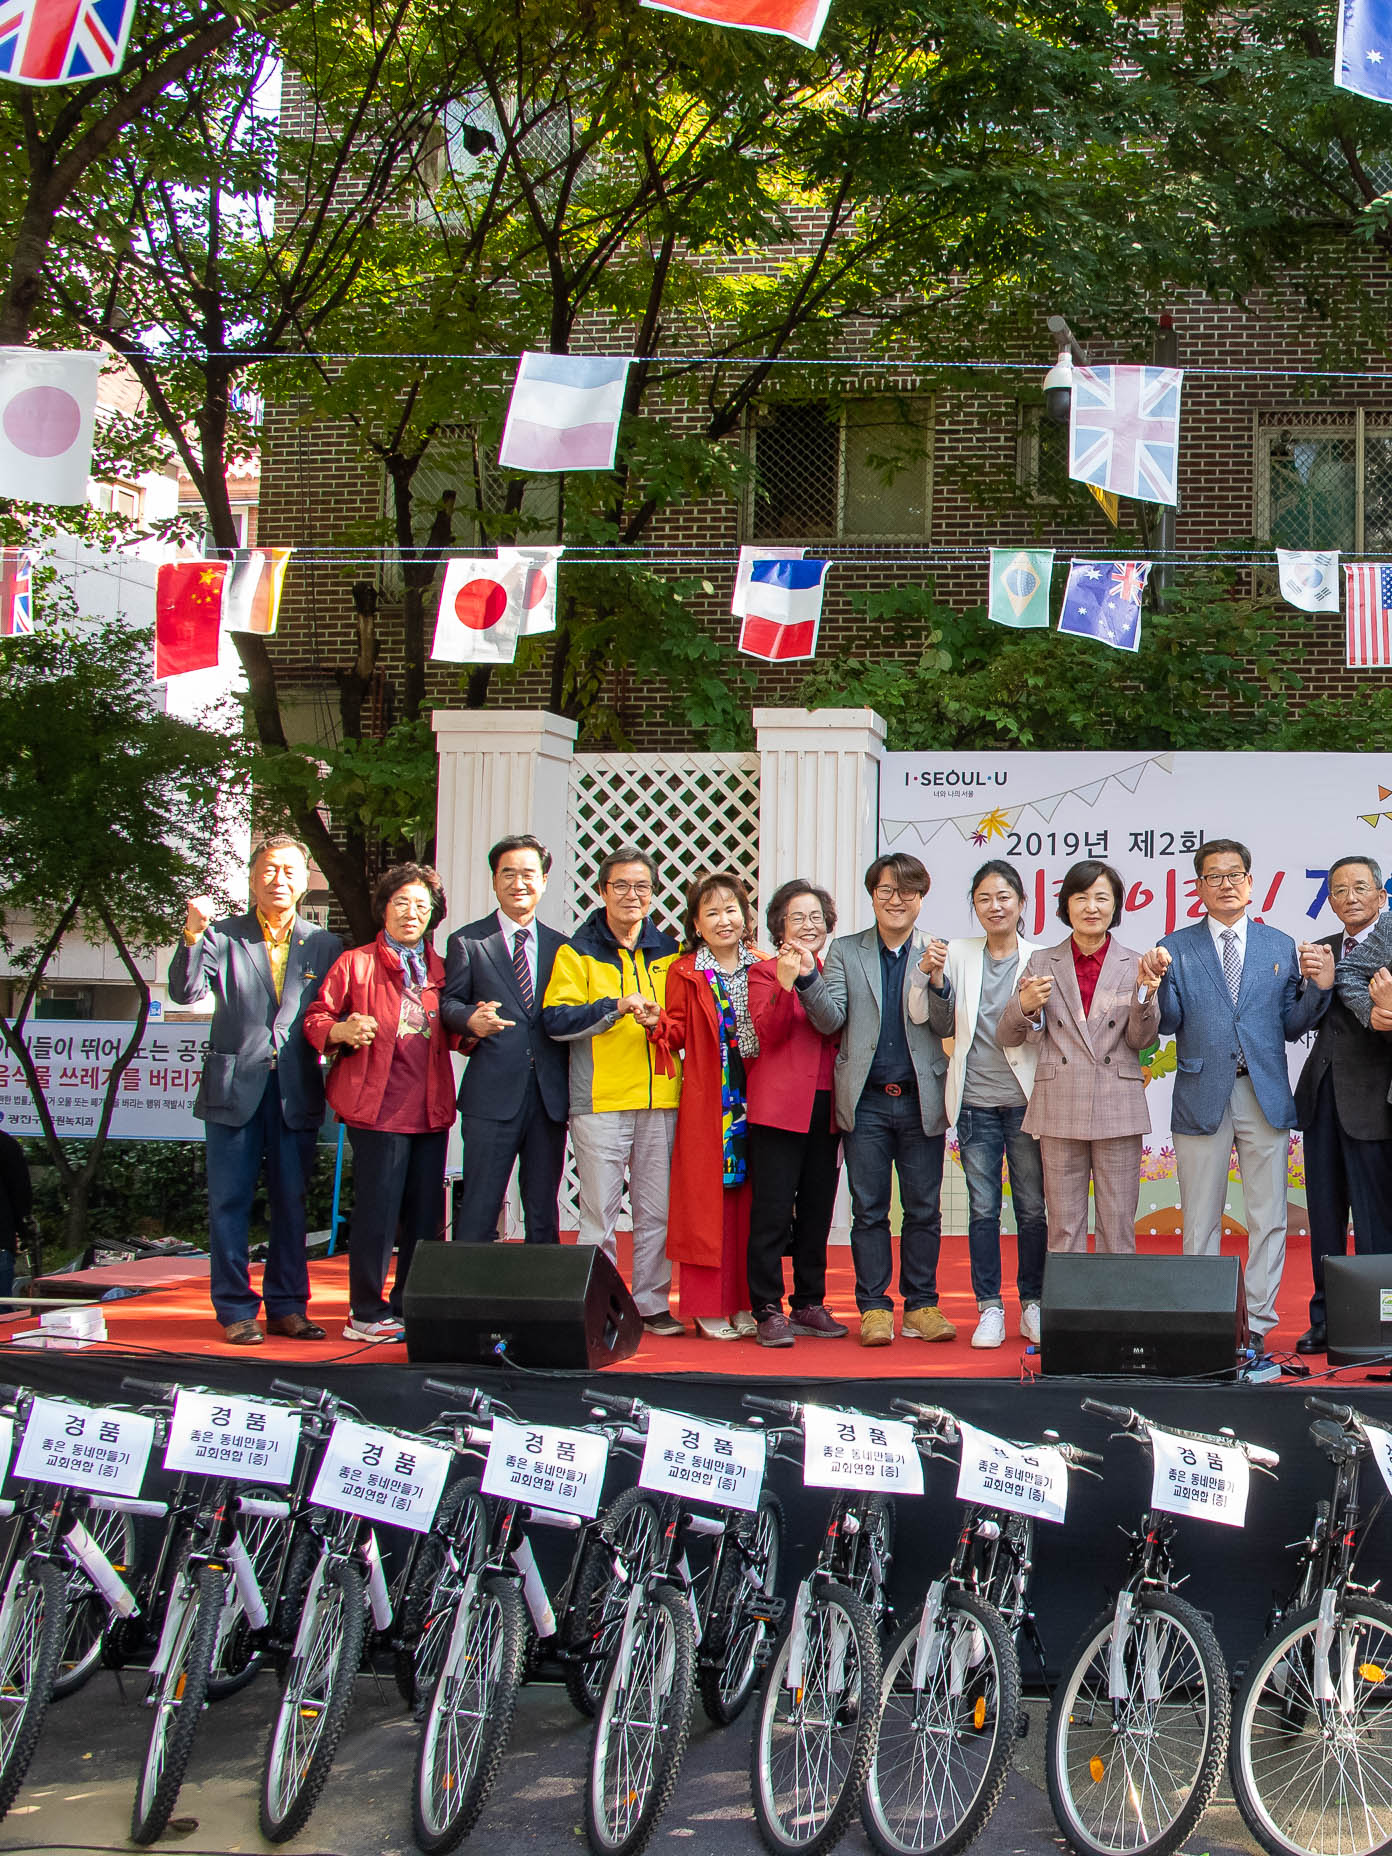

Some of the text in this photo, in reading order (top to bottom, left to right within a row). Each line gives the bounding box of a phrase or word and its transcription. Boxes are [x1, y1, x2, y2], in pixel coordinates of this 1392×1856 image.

[933, 790, 974, 798] 너와 나의 서울
[1006, 830, 1206, 859] 2019년 제2회
[81, 1037, 121, 1061] 뛰어
[42, 1438, 130, 1464] 좋은 동네만들기
[191, 1430, 278, 1452] 좋은 동네만들기
[46, 1454, 94, 1473] 교회연합
[196, 1446, 242, 1462] 교회연합
[664, 1449, 746, 1478] 좋은 동네만들기
[824, 1445, 904, 1464] 좋은 동네만들기
[506, 1454, 586, 1484] 좋은 동네만들기
[668, 1466, 712, 1486] 교회연합
[831, 1462, 874, 1476] 교회연합
[978, 1460, 1052, 1490] 좋은 동네만들기
[339, 1466, 424, 1498] 좋은 동네만들기
[510, 1472, 554, 1492] 교회연합
[984, 1476, 1024, 1496] 교회연합
[1169, 1468, 1234, 1493] 좋은 동네만들기
[342, 1482, 388, 1504] 교회연합
[1174, 1484, 1208, 1503] 교회연합
